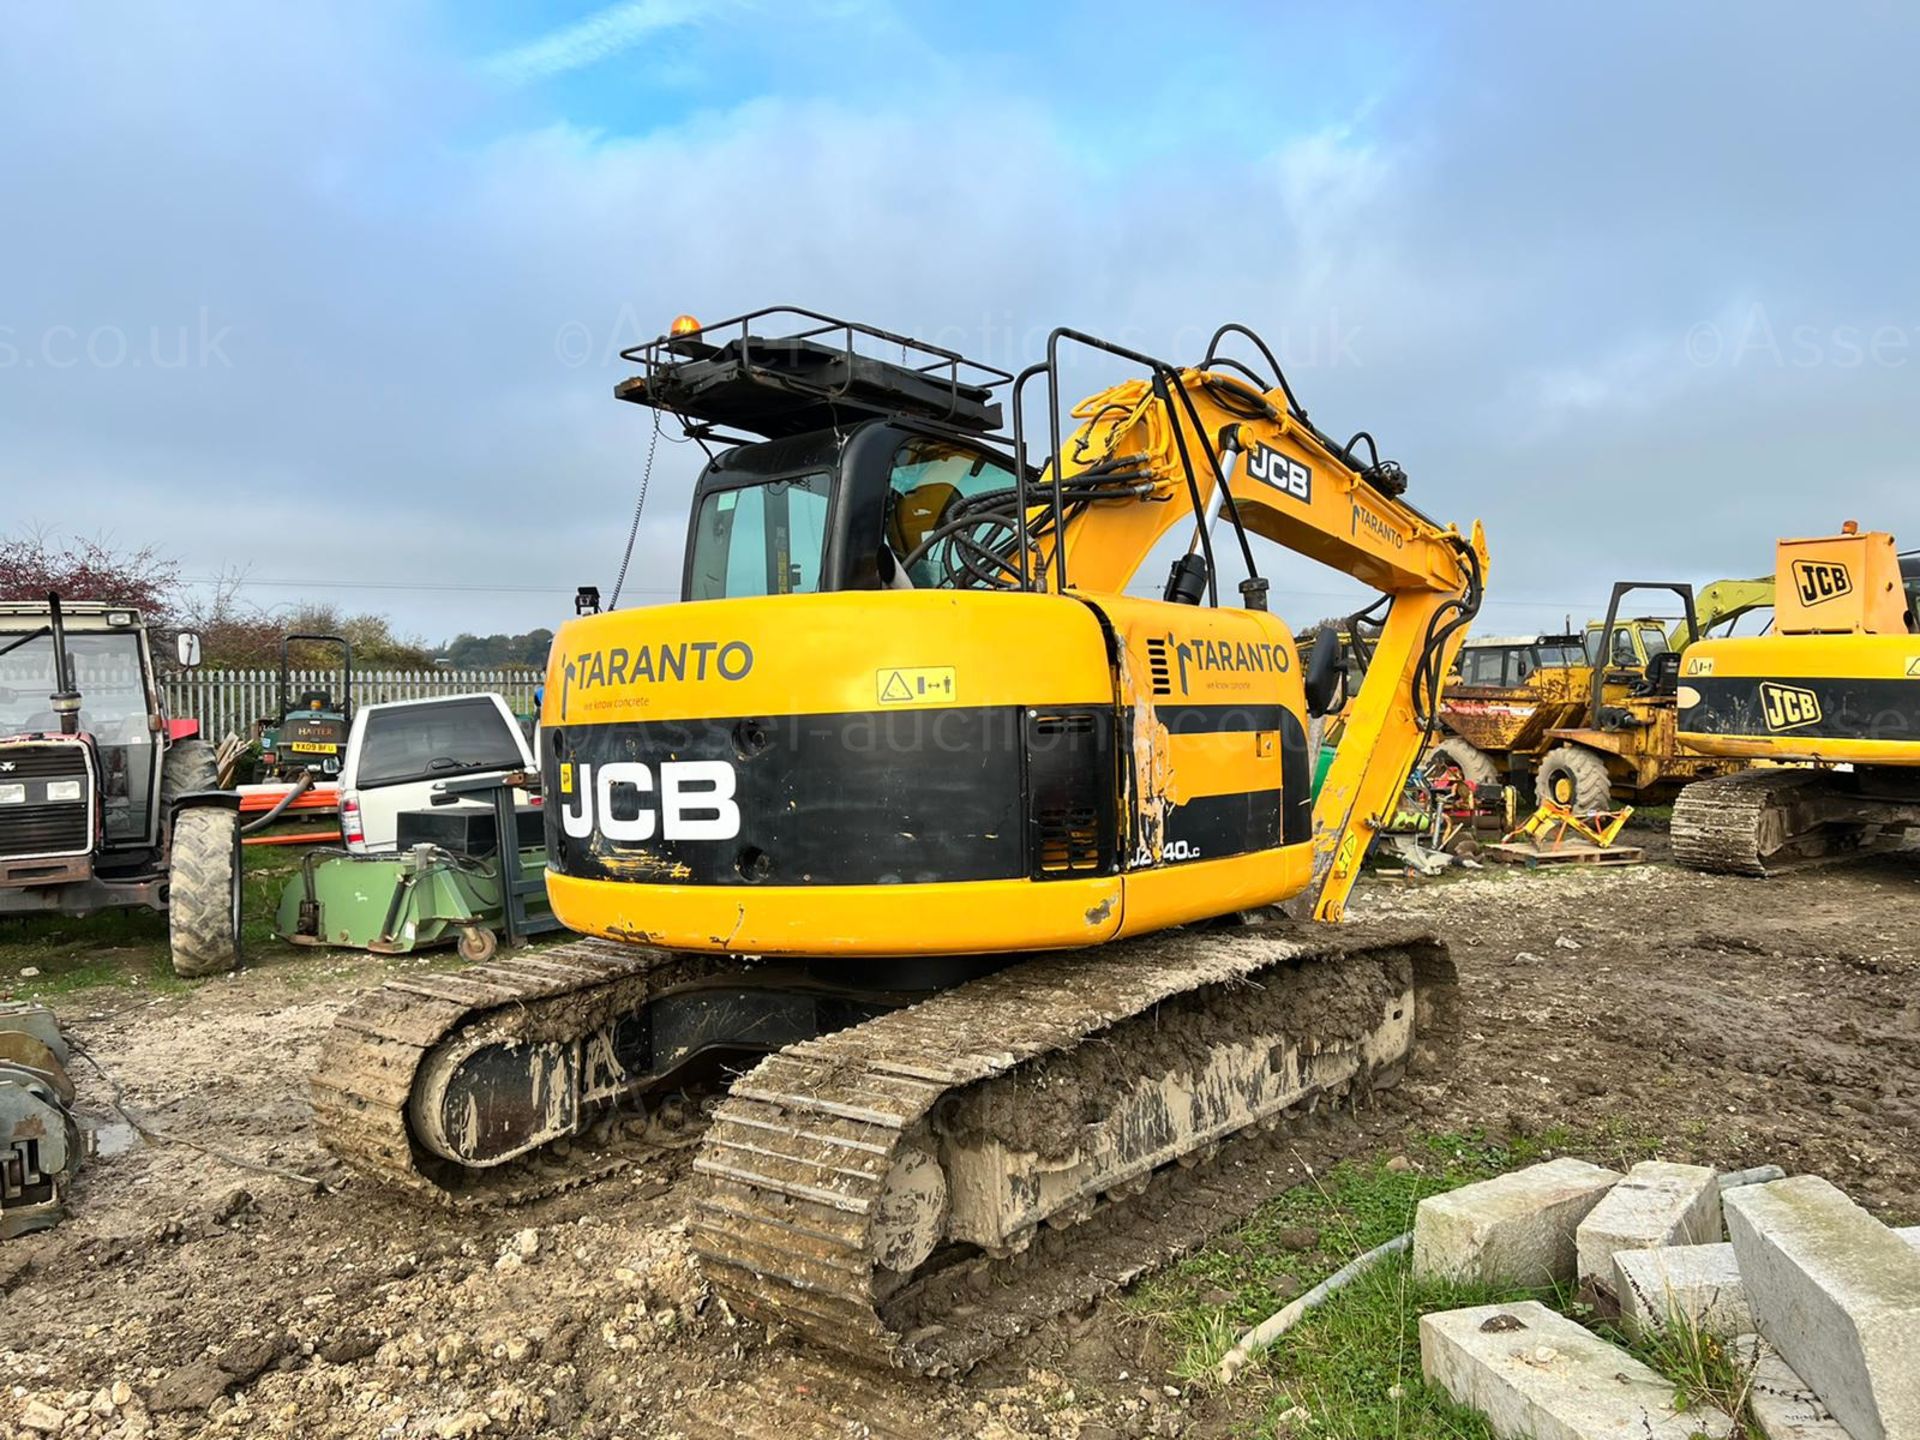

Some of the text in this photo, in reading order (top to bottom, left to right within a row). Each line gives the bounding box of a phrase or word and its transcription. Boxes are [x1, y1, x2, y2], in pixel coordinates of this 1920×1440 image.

[1251, 447, 1309, 499] JCB
[1360, 507, 1403, 549] TARANTO
[1802, 565, 1847, 601] JCB
[577, 640, 754, 690] TARANTO
[1190, 638, 1290, 673] TARANTO
[1768, 687, 1816, 727] JCB
[561, 760, 741, 841] JCB
